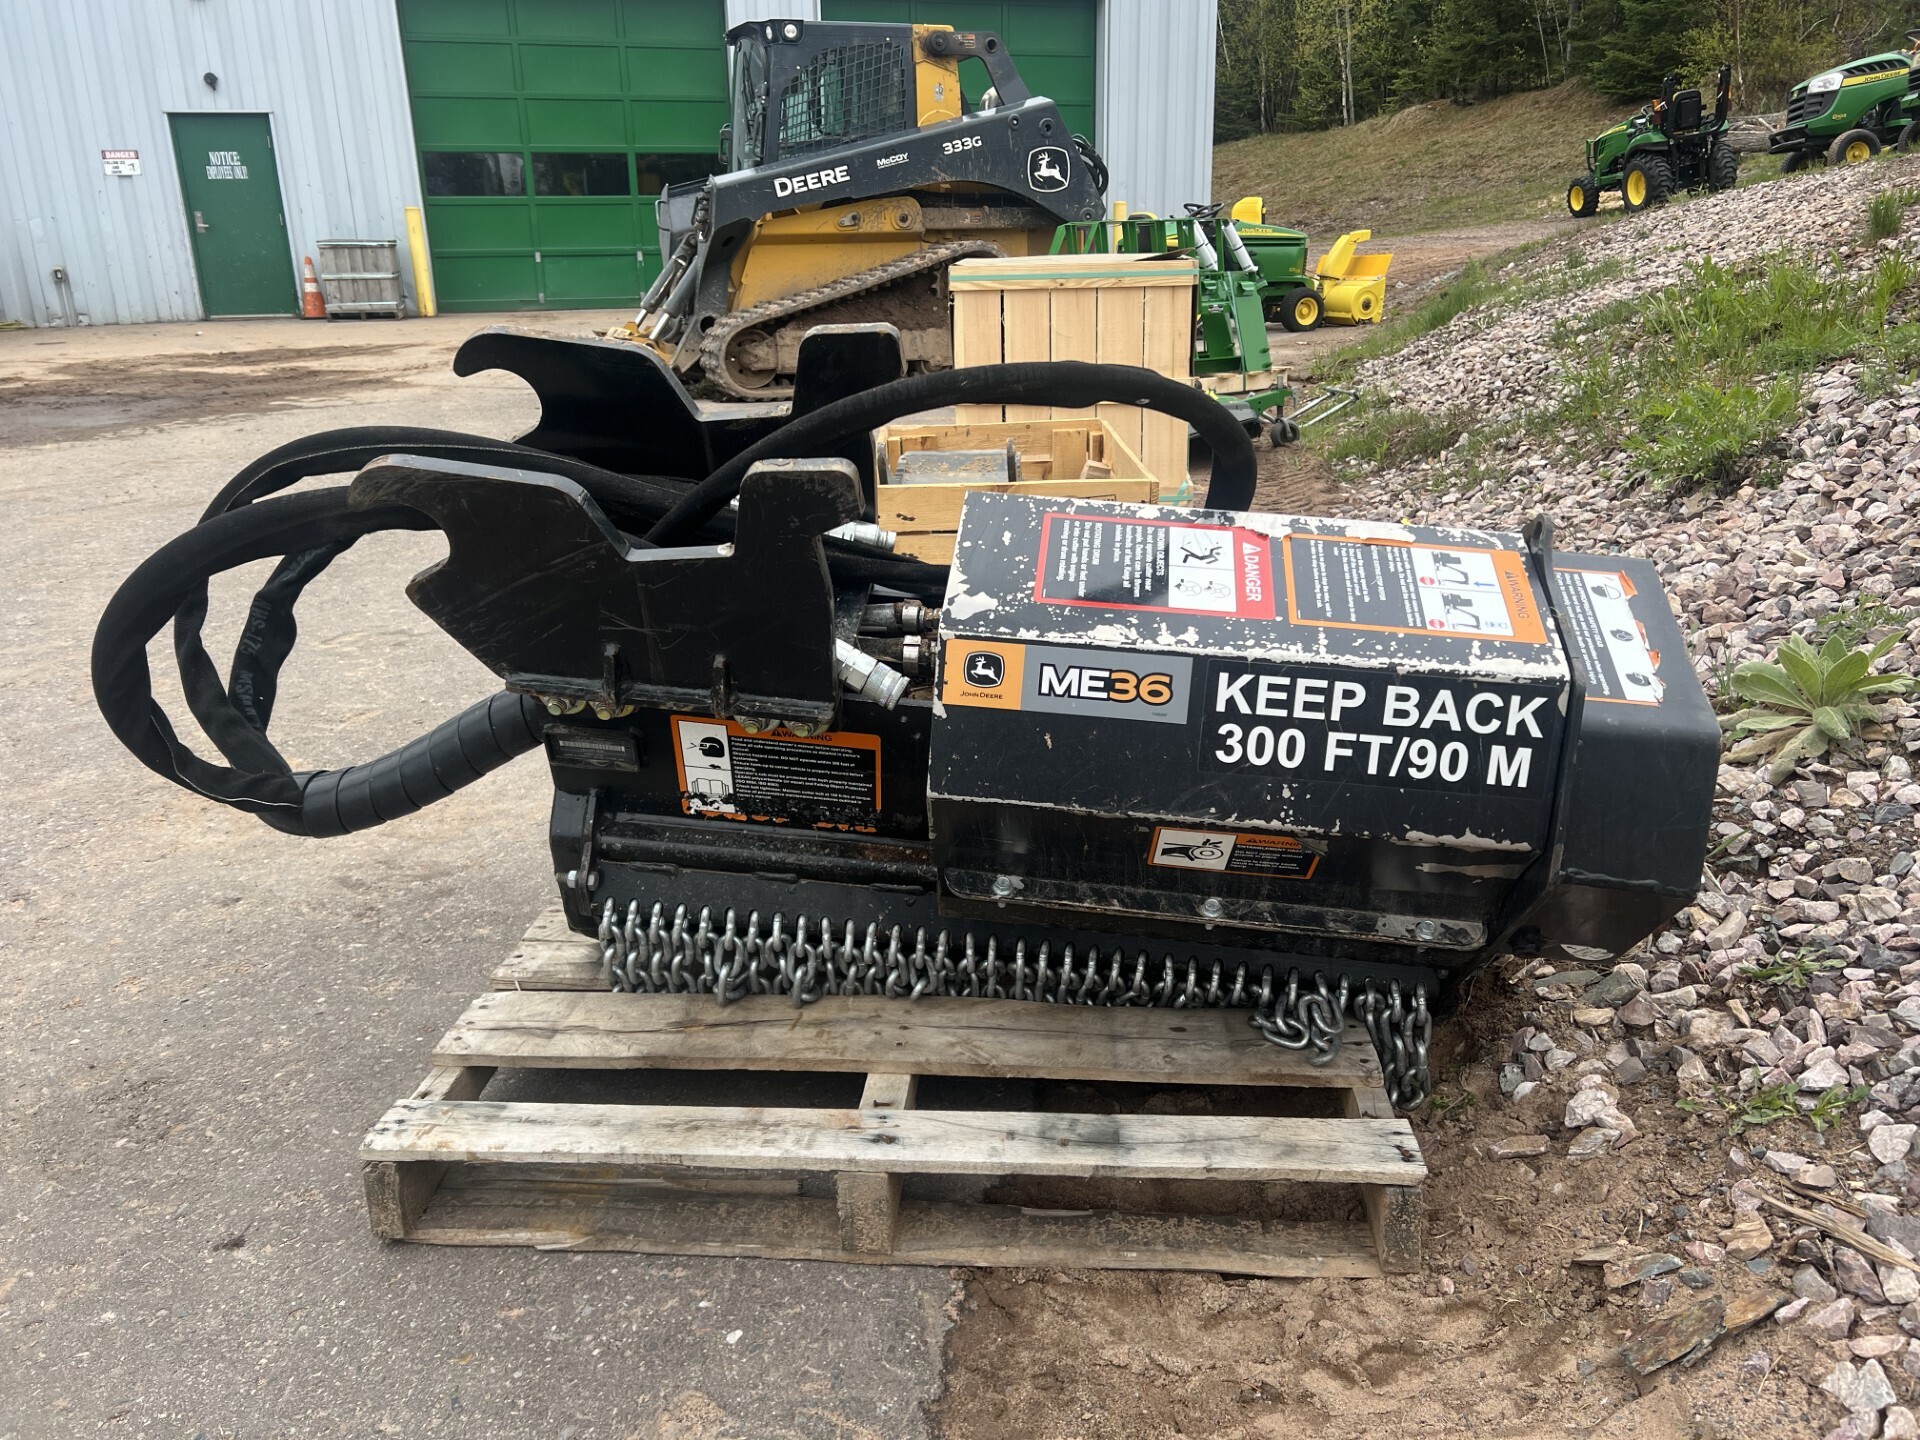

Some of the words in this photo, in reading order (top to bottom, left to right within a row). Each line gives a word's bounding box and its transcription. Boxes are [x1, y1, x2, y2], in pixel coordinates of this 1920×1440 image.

[105, 151, 136, 159] DANGER
[208, 151, 241, 166] NOTICE:
[942, 136, 982, 155] 333G
[774, 165, 850, 198] DEERE
[1244, 555, 1262, 602] DANGER
[1508, 579, 1530, 618] WARNING
[960, 690, 980, 698] JOHN
[980, 692, 1004, 700] DEERE
[1038, 663, 1174, 706] ME36
[1216, 672, 1367, 721] KEEP
[1382, 685, 1549, 738] BACK
[1214, 723, 1306, 769] 300
[1324, 731, 1469, 782] FT/90
[1486, 745, 1533, 788] M
[1259, 839, 1300, 847] WARNI
